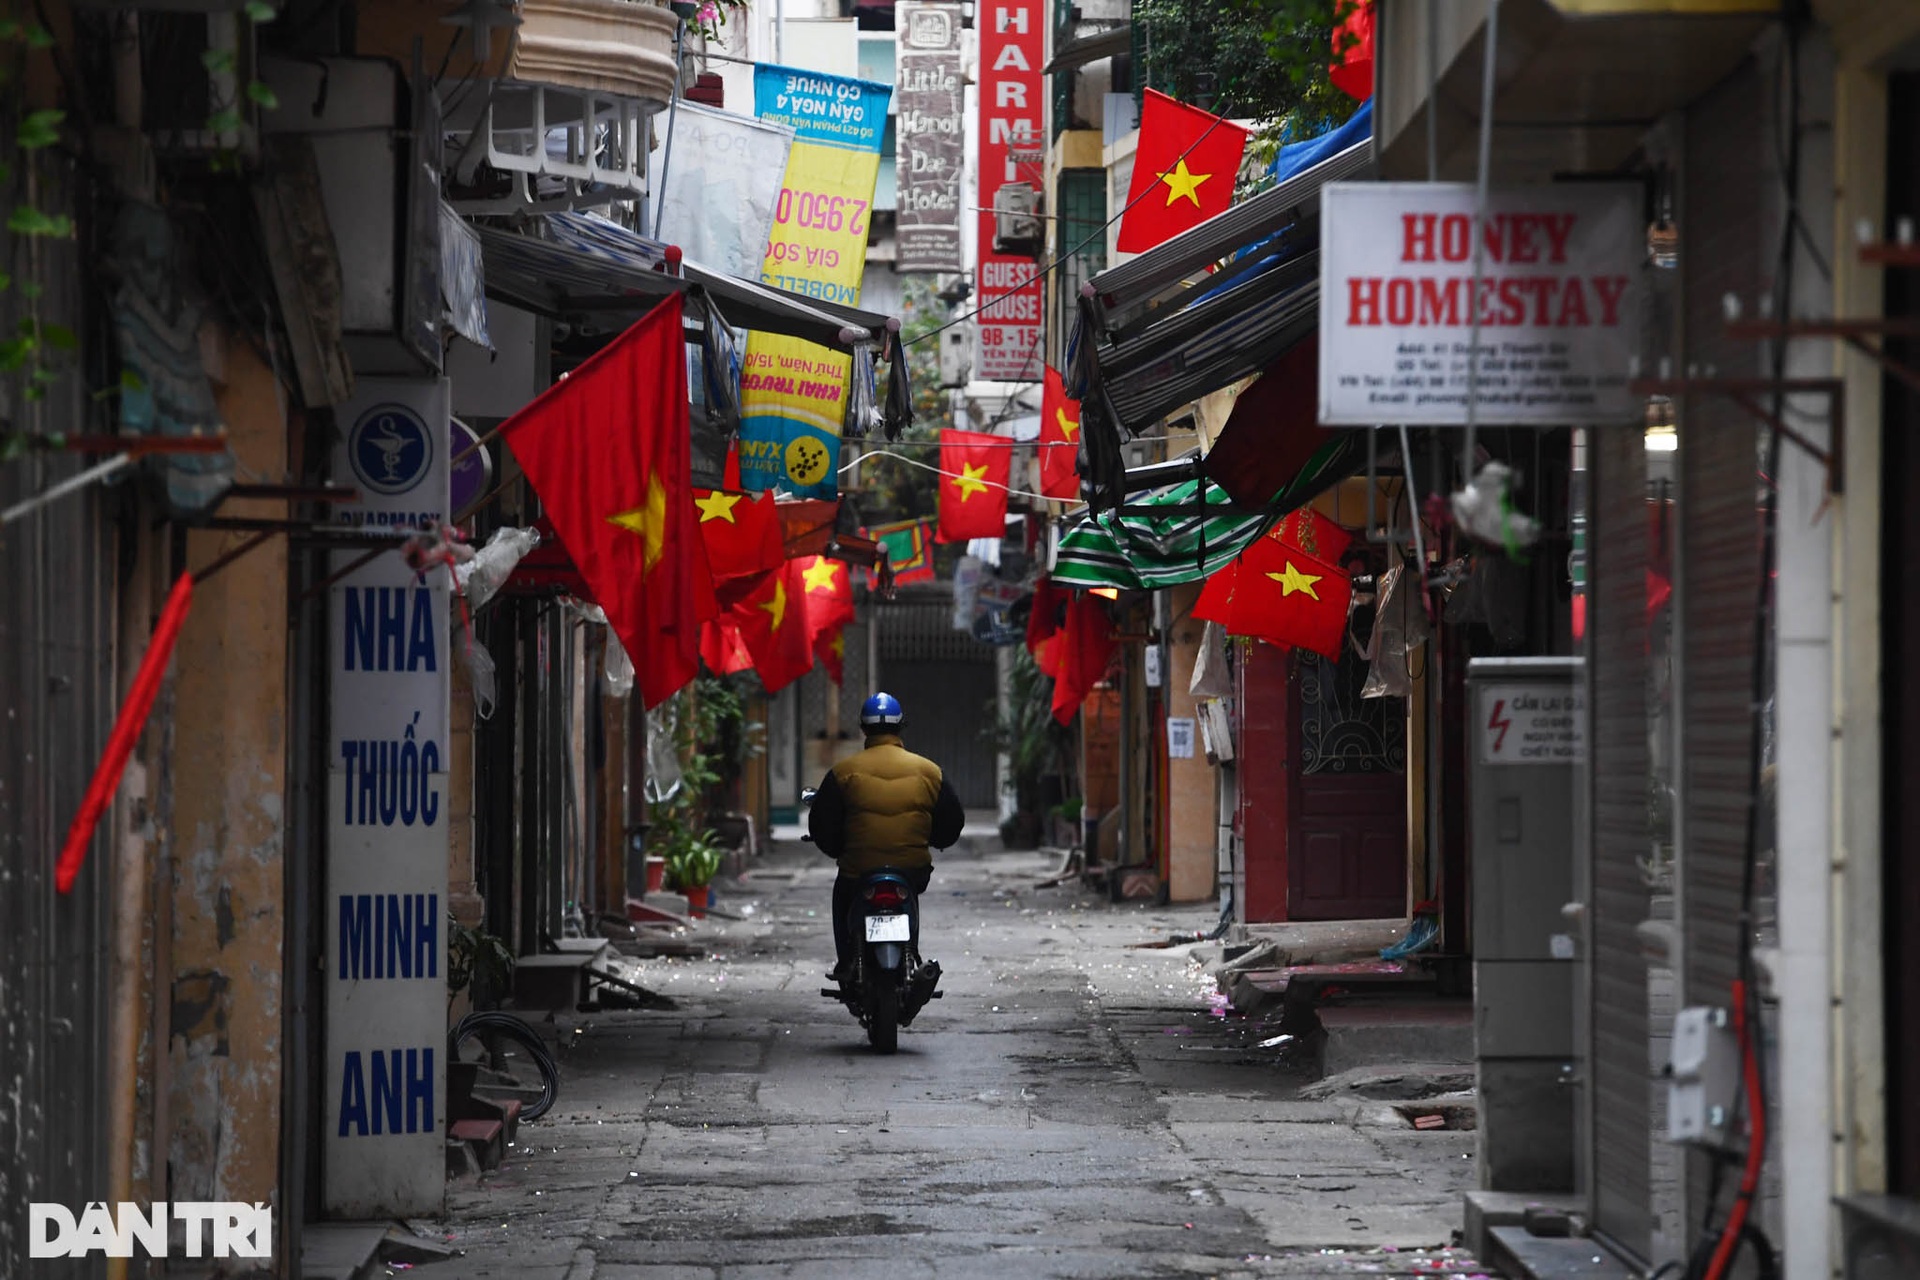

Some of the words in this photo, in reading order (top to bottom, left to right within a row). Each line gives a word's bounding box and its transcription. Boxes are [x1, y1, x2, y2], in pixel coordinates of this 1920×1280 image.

[902, 65, 957, 92] Little
[776, 93, 788, 109] 4
[989, 7, 1033, 181] HARMI
[902, 110, 959, 135] Hanoi
[902, 186, 957, 214] Hotel
[1402, 212, 1577, 263] HONEY
[806, 246, 839, 269] GIÁ
[982, 262, 1039, 288] GUEST
[982, 294, 1038, 319] HOUSE
[1346, 276, 1629, 327] HOMESTAY
[982, 328, 1003, 346] 9B
[1018, 328, 1038, 346] 15
[815, 362, 843, 380] Thứ
[797, 380, 841, 401] KHAI
[344, 571, 437, 672] NHÀ
[341, 711, 439, 827] THUỐC
[338, 894, 438, 980] MINH
[338, 1047, 434, 1137] ANH
